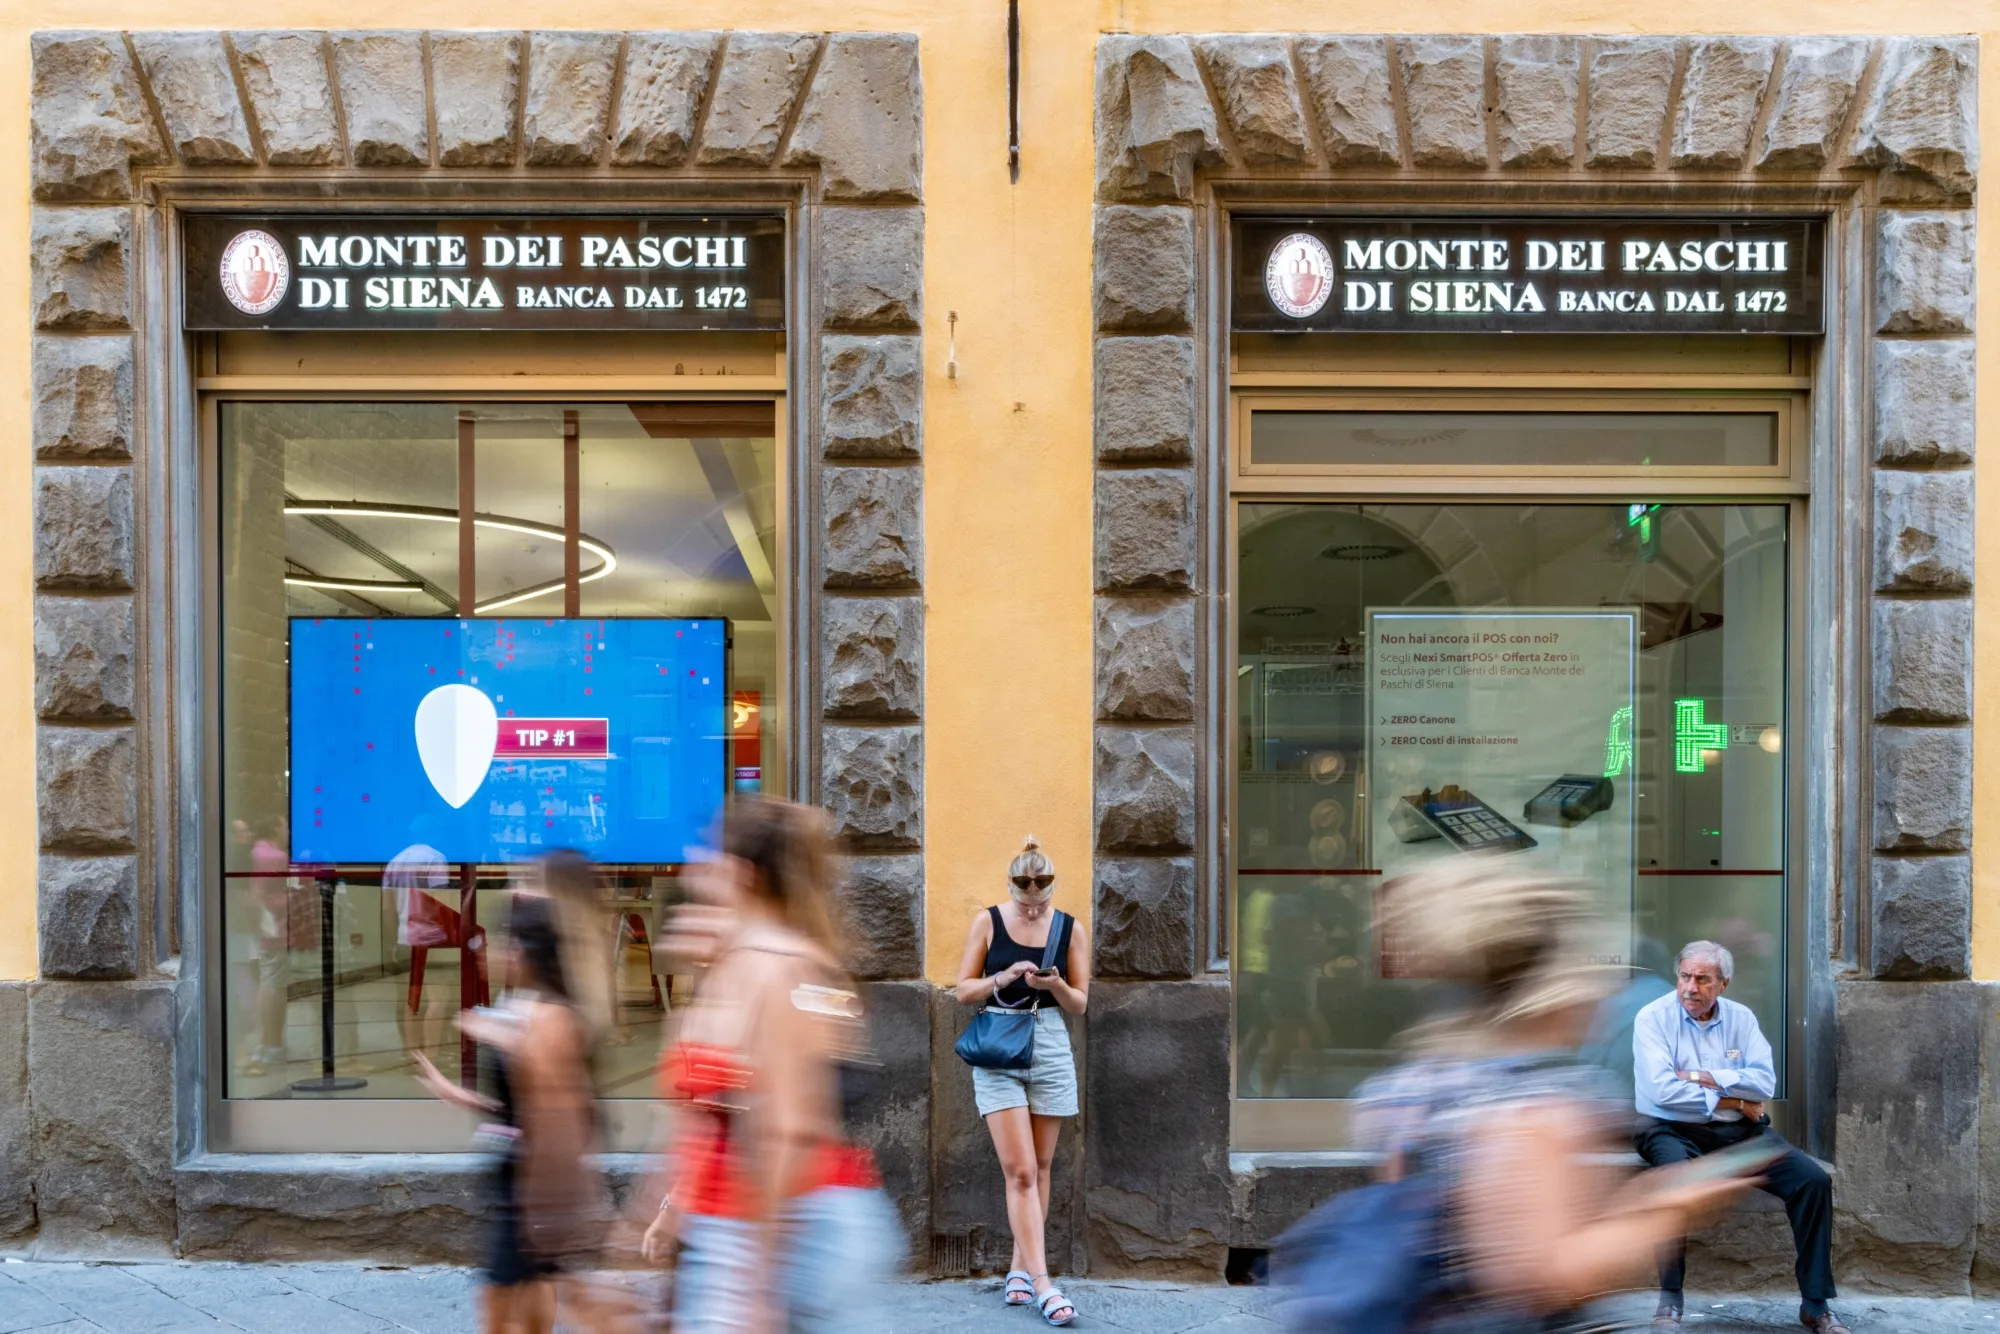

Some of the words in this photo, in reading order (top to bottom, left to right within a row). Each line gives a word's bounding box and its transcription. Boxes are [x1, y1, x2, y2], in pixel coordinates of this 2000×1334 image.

[298, 236, 466, 267] MONTE
[482, 236, 562, 267] DEI
[580, 236, 747, 267] PASCHI
[1344, 240, 1509, 271] MONTE
[1525, 241, 1605, 271] DEI
[1623, 240, 1788, 272] PASCHI
[298, 278, 349, 308] DI
[365, 277, 504, 309] SIENA
[516, 286, 614, 308] BANCA
[624, 286, 683, 308] DAL
[695, 286, 747, 308] 1472
[1344, 281, 1393, 312] DI
[1410, 281, 1546, 313] SIENA
[1558, 291, 1655, 312] BANCA
[1666, 291, 1724, 312] DAL
[1735, 291, 1788, 312] 1472
[1381, 633, 1406, 644] Non
[1408, 632, 1427, 644] hai
[1429, 635, 1470, 644] ancora
[1472, 632, 1480, 644] il
[1483, 633, 1507, 644] POS
[1509, 635, 1531, 644] con
[1534, 632, 1559, 644] noi?
[1380, 652, 1411, 665] Scegli
[1413, 652, 1438, 662] Nexi
[1502, 652, 1541, 662] Offerta
[1543, 652, 1568, 662] Zero
[1570, 652, 1580, 662] in
[1380, 665, 1425, 676] esclusiva
[1428, 668, 1446, 678] per
[1453, 665, 1486, 676] Clienti
[1488, 665, 1498, 676] di
[1500, 665, 1530, 676] Banca
[1532, 665, 1567, 676] Monte
[1568, 664, 1586, 676] dei
[1380, 679, 1412, 689] Paschi
[1414, 679, 1425, 689] di
[1427, 679, 1454, 689] Siena
[1390, 715, 1417, 724] ZERO
[1419, 715, 1456, 724] Canone
[515, 729, 549, 747] TIP
[552, 729, 575, 747] #1
[1390, 736, 1417, 745] ZERO
[1419, 735, 1444, 745] Costi
[1446, 735, 1456, 745] di
[1457, 735, 1519, 745] installazione
